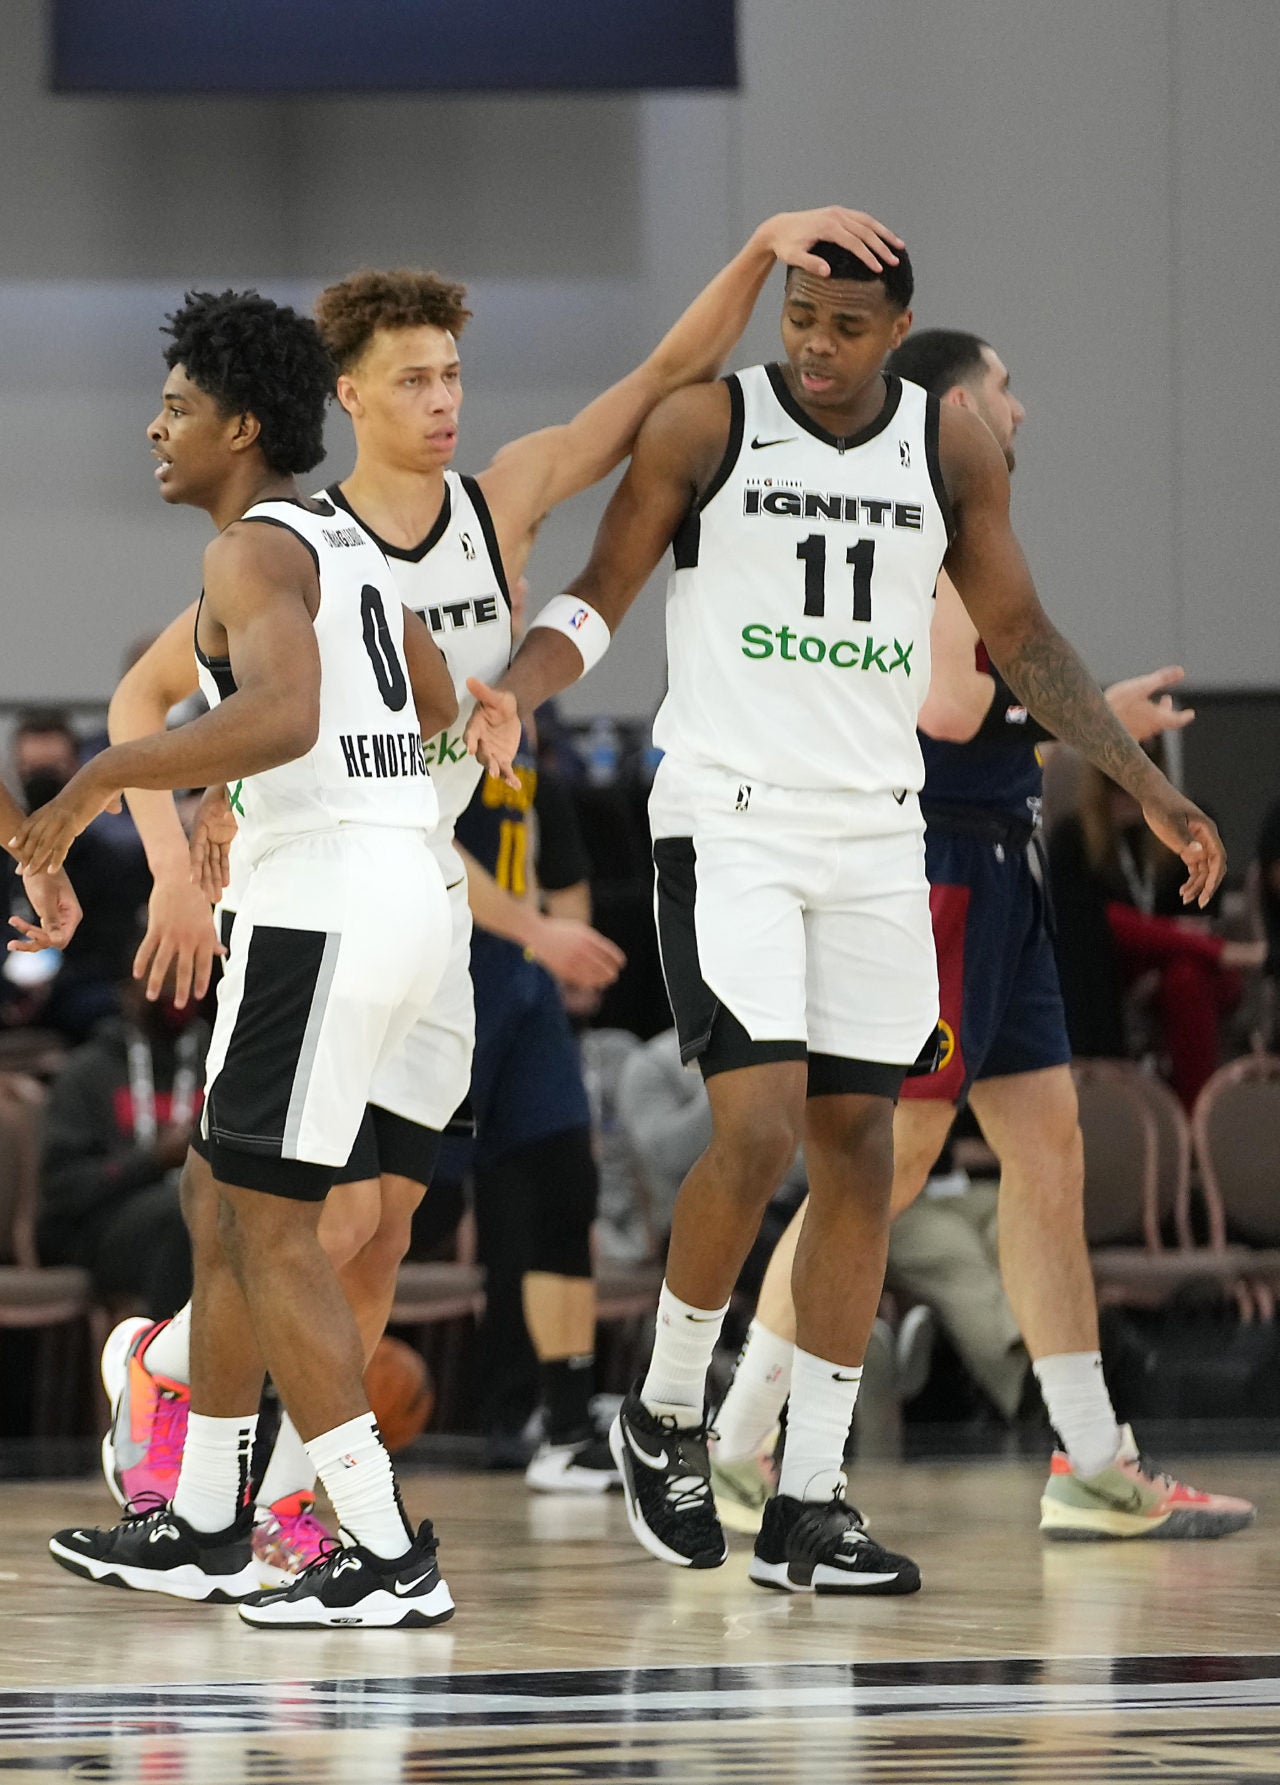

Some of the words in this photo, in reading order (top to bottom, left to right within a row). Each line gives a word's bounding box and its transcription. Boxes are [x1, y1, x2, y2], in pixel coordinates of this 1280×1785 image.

[744, 489, 924, 531] IGNITE
[796, 534, 875, 622] 11
[360, 584, 407, 712] 0
[741, 624, 914, 678] StockX
[339, 732, 430, 778] HENDERS
